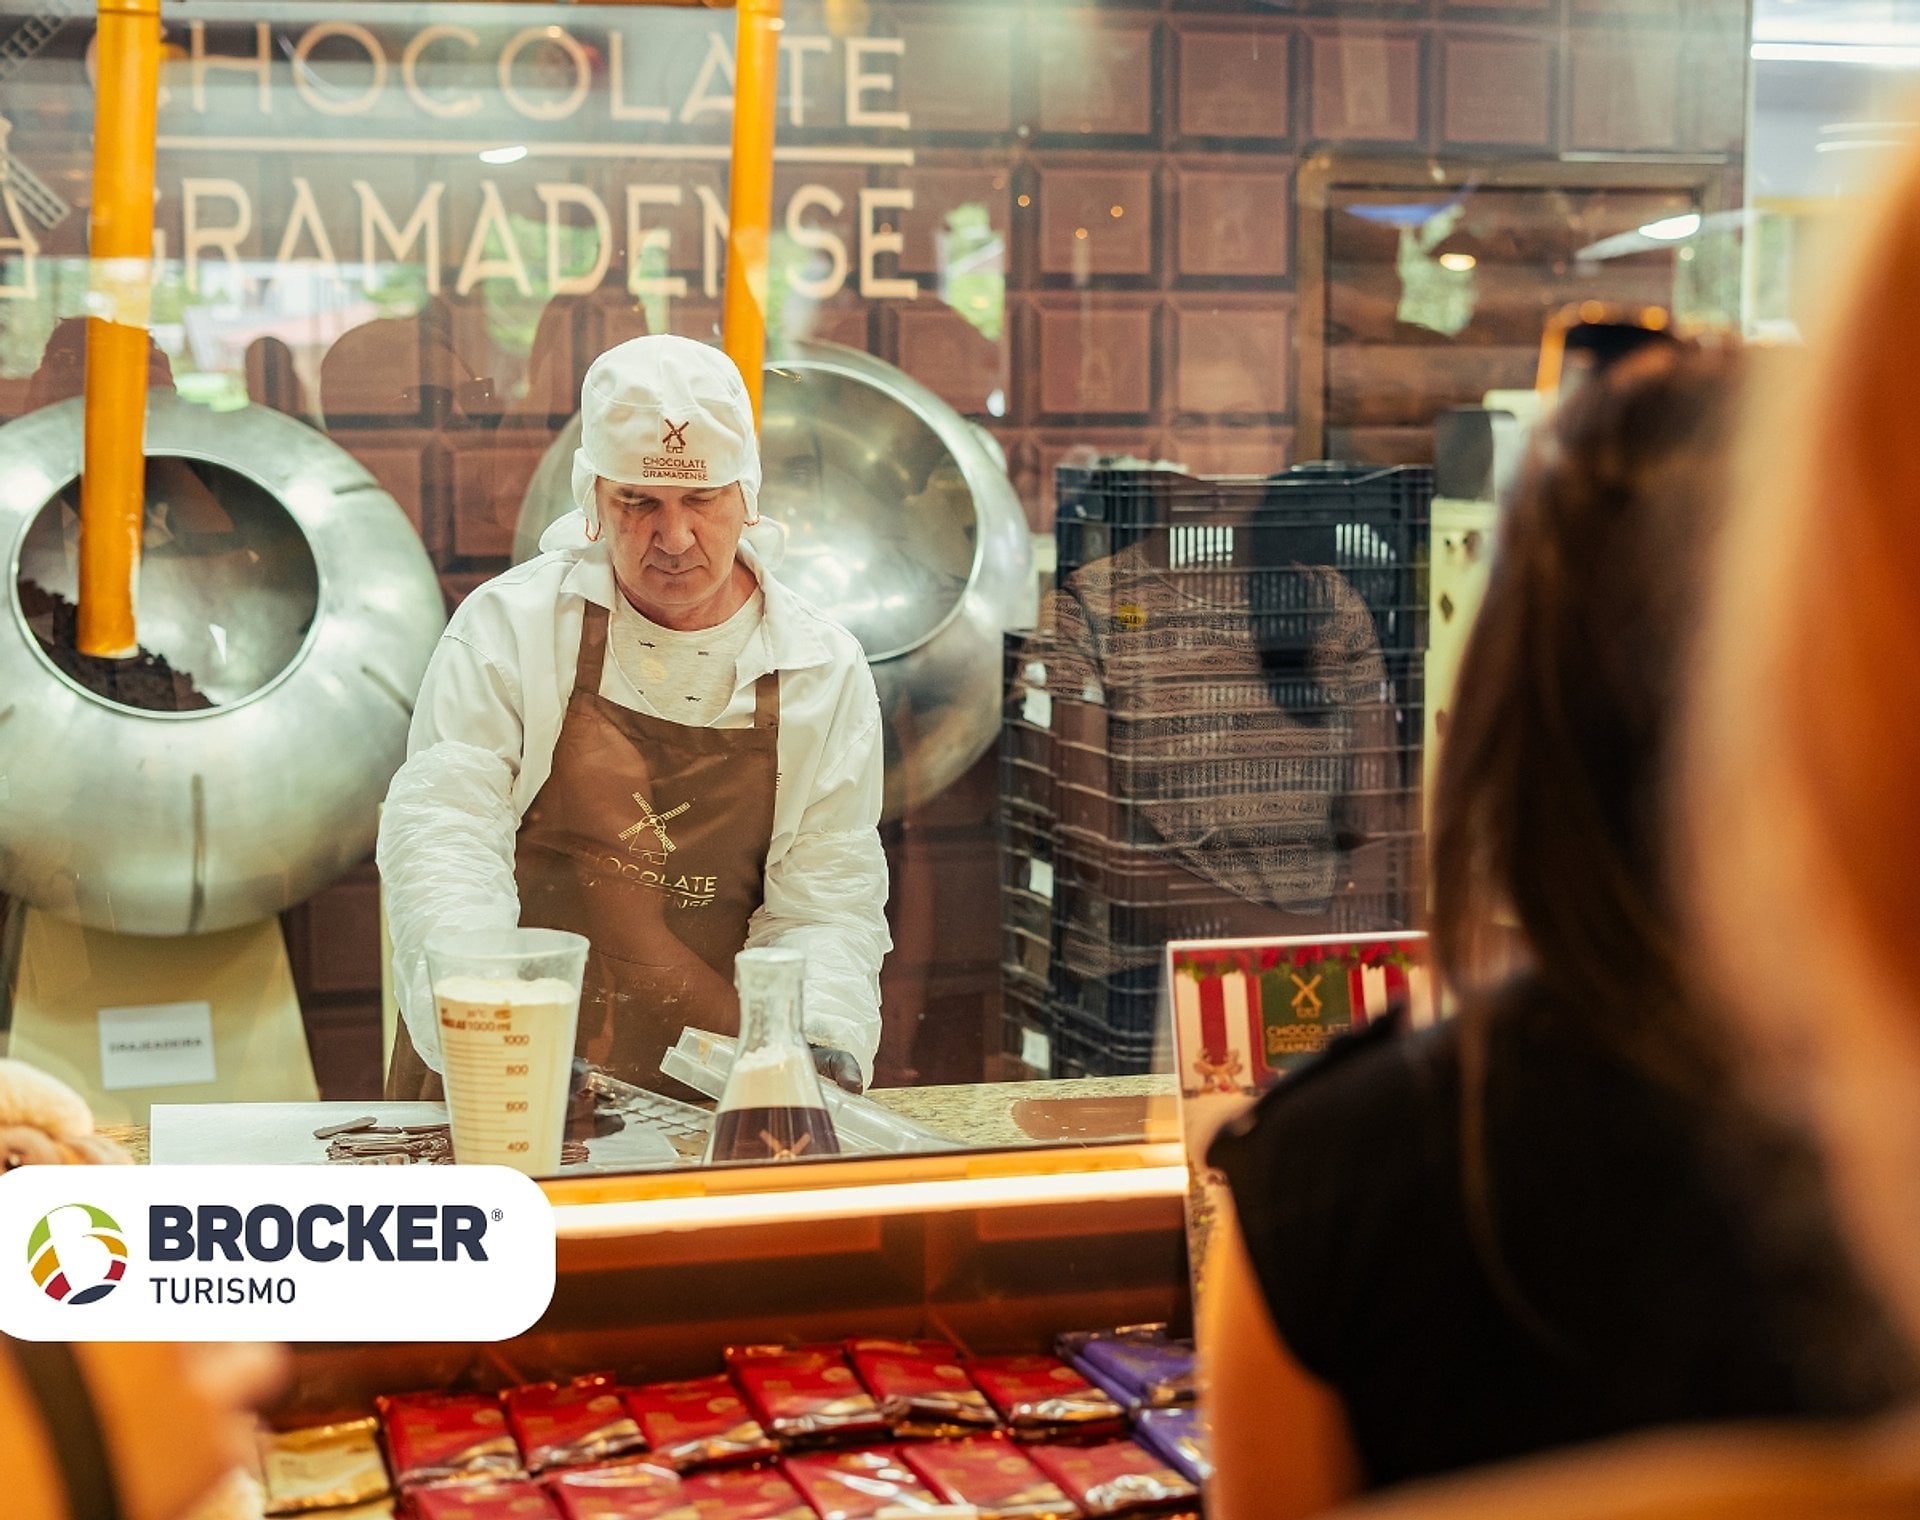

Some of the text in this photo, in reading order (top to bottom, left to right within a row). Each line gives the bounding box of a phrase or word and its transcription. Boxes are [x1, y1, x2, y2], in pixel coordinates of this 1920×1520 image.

[643, 457, 706, 468] CHOCOLATE
[643, 470, 708, 480] GRAMADENSE
[504, 1035, 529, 1045] 1000
